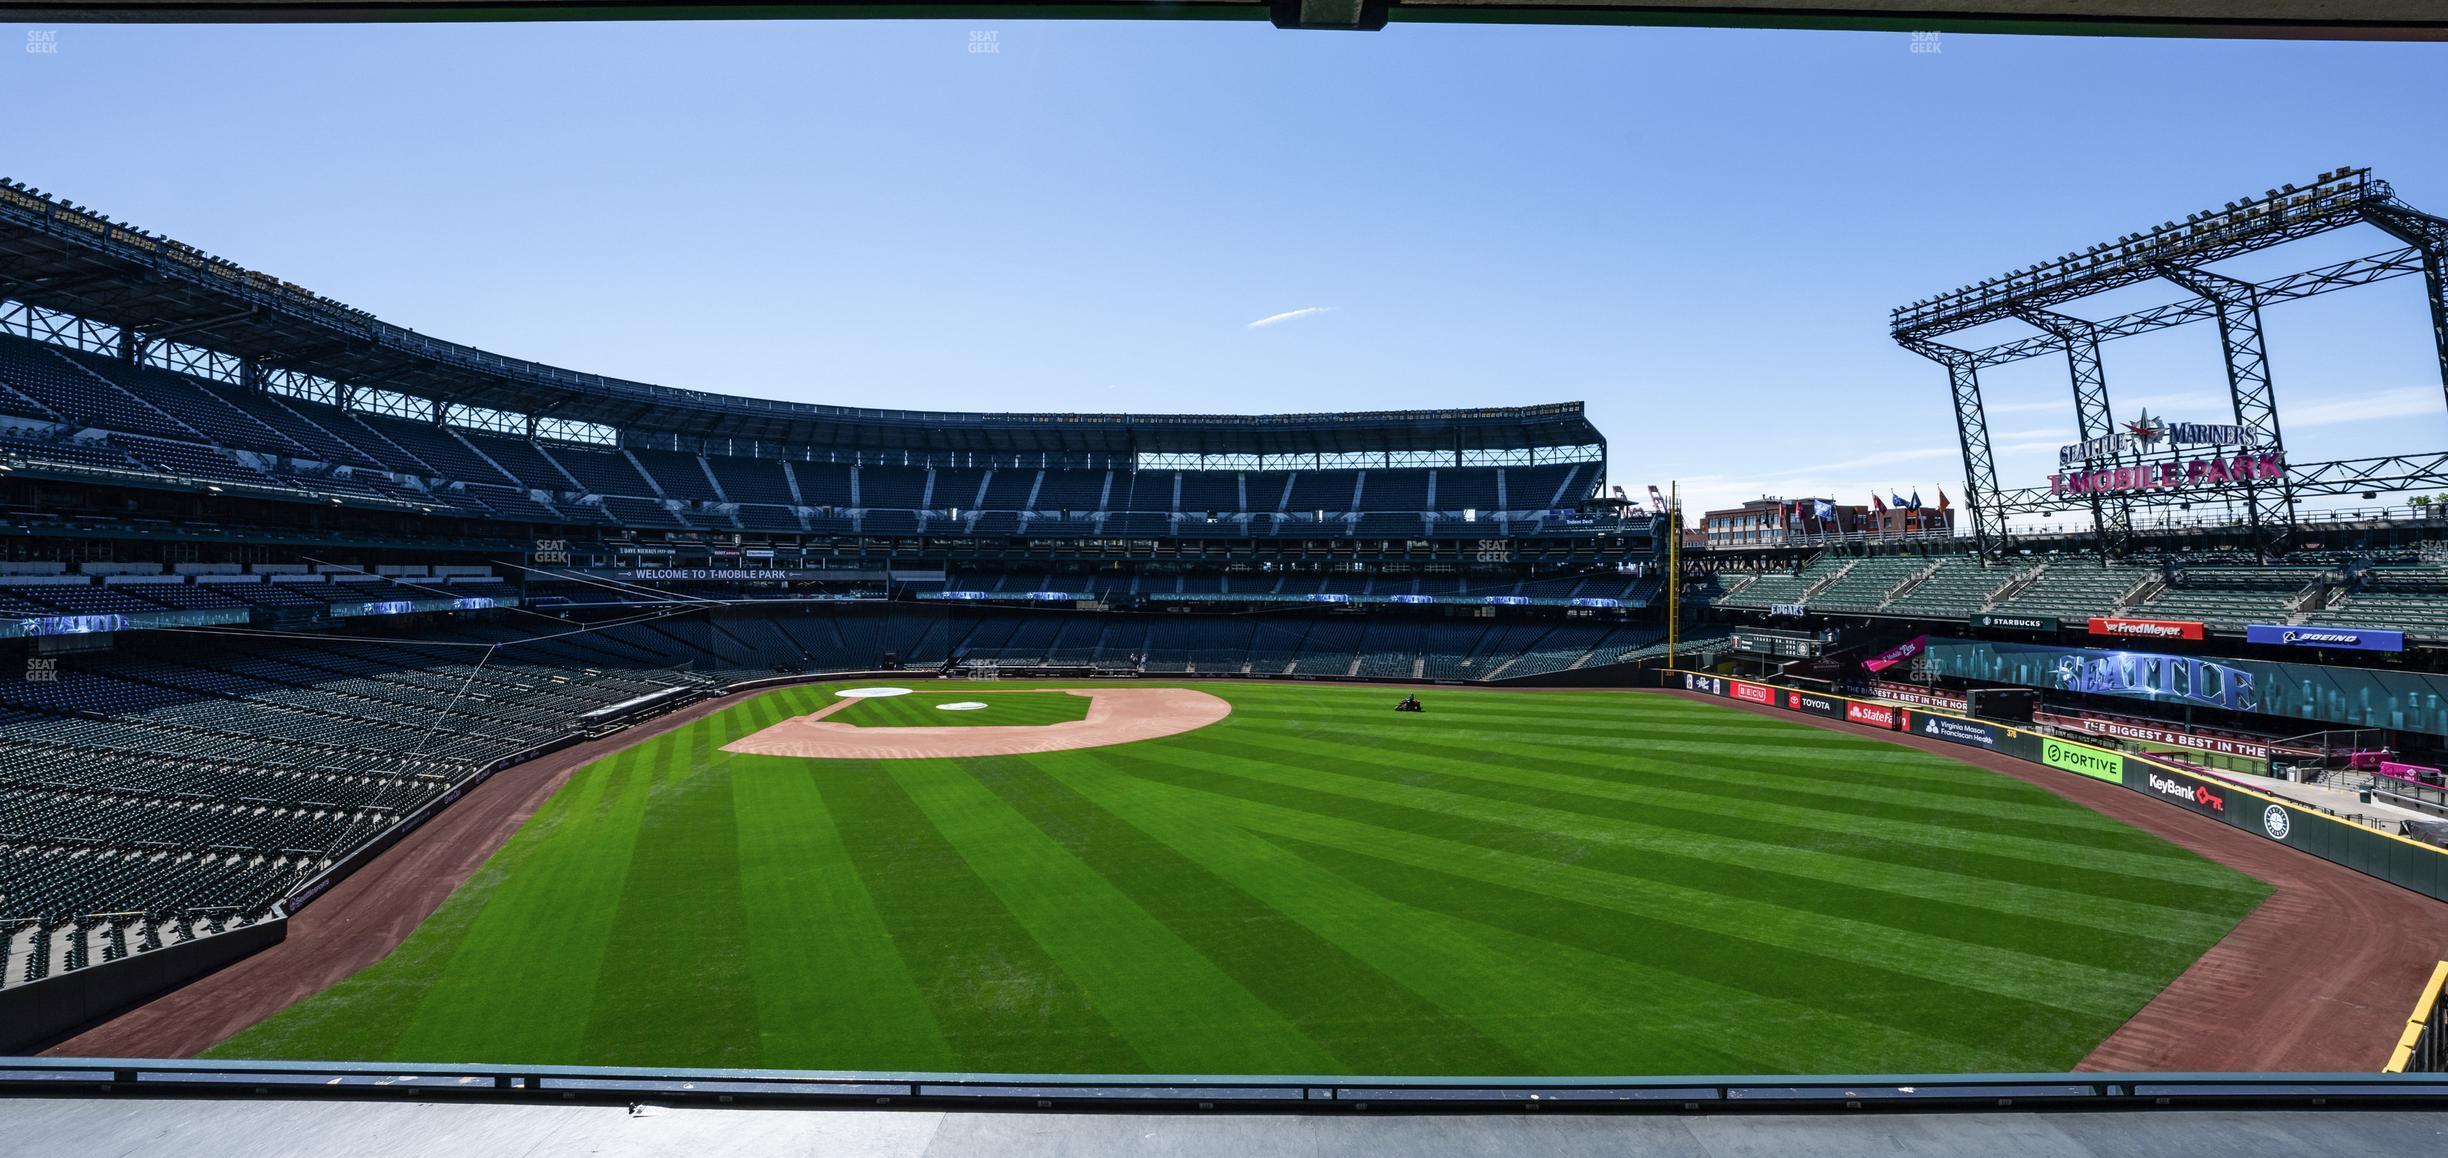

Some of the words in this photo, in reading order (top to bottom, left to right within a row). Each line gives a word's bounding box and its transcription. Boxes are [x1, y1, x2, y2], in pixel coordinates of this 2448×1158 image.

[2060, 433, 2128, 466] SEATTLE
[2168, 422, 2258, 447] MARINERS
[2047, 461, 2182, 496] T-MOBILE
[2188, 449, 2287, 485] PARK
[636, 569, 688, 579] WELCOME
[692, 569, 706, 579] TO
[709, 569, 756, 579] T-MOBILE
[758, 569, 786, 579] PARK
[1993, 618, 2041, 627] STARBUCKS
[2301, 633, 2358, 642] BOEING
[1740, 687, 1764, 698] BECU
[1802, 698, 1831, 710] TOYOTA
[1900, 693, 1920, 702] BEST
[1931, 698, 1948, 707] THE
[1941, 721, 1964, 732] Virginia
[1964, 725, 1985, 734] Mason
[1941, 729, 1973, 740] Franciscan
[1974, 735, 1993, 744] Health
[2109, 725, 2162, 741] BIGGEST
[2165, 733, 2174, 742] &
[2179, 734, 2212, 749] BEST
[2217, 740, 2232, 751] IN
[2236, 744, 2266, 757] THE
[2063, 751, 2117, 775] FORTIVE
[2149, 774, 2195, 801] KeyBank
